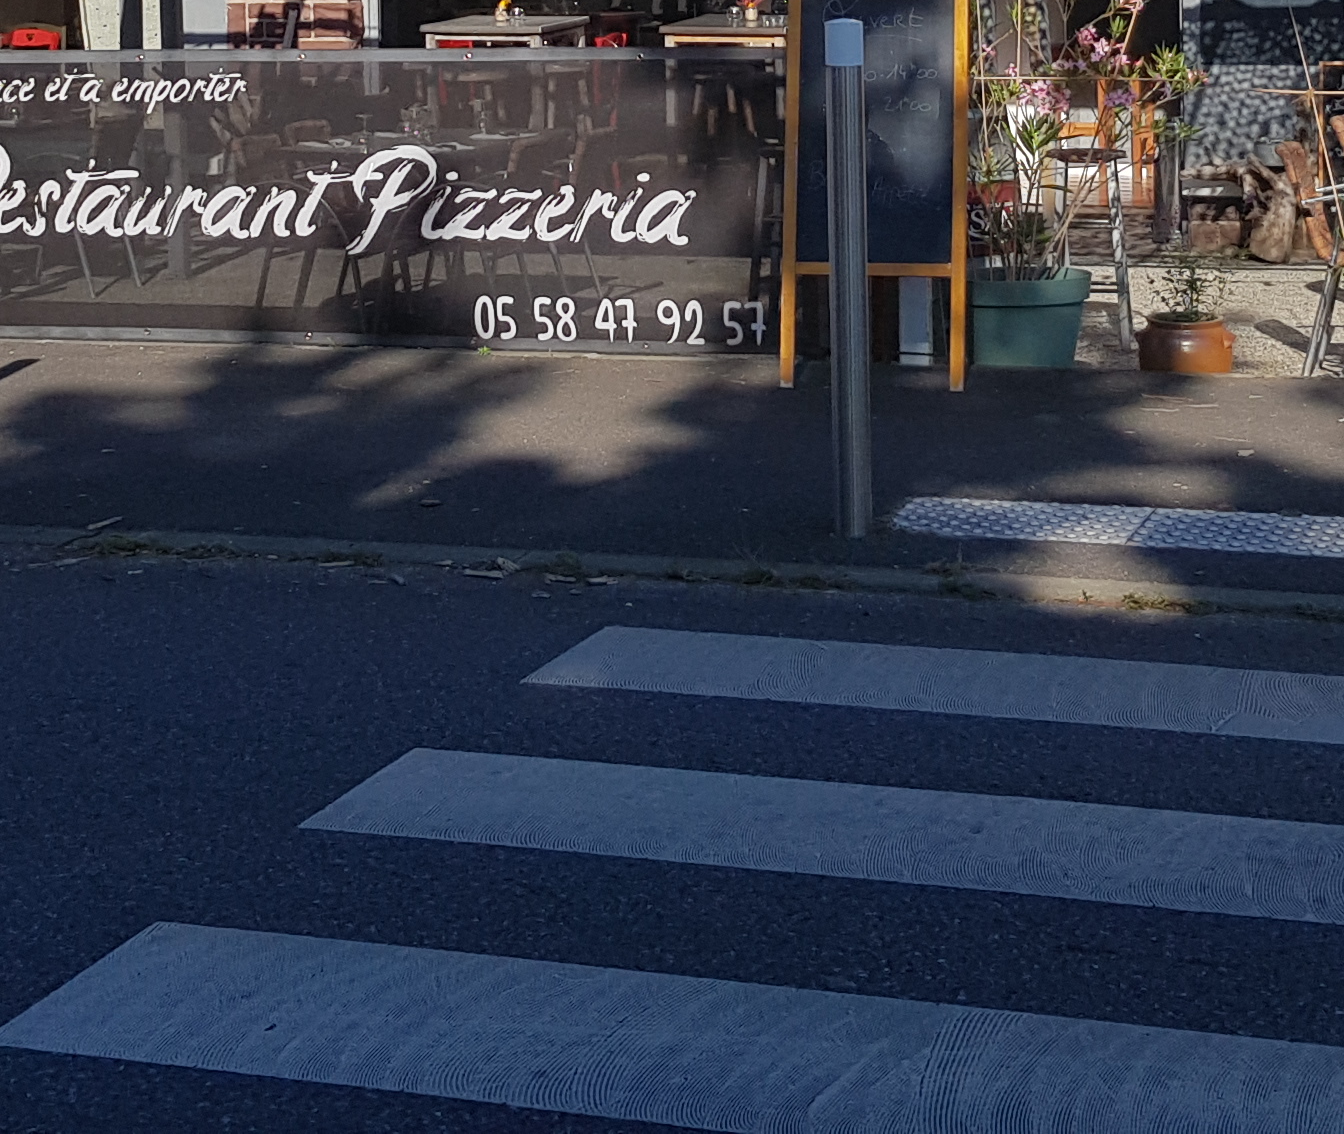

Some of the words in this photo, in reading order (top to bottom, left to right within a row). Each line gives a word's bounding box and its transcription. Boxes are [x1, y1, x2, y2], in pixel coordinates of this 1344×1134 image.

[112, 68, 248, 115] emporter
[347, 144, 691, 256] Pizzeria
[474, 294, 517, 340] 05
[533, 296, 577, 342] 58
[594, 298, 638, 344] 47
[656, 299, 705, 345] 92
[723, 301, 767, 346] 57
